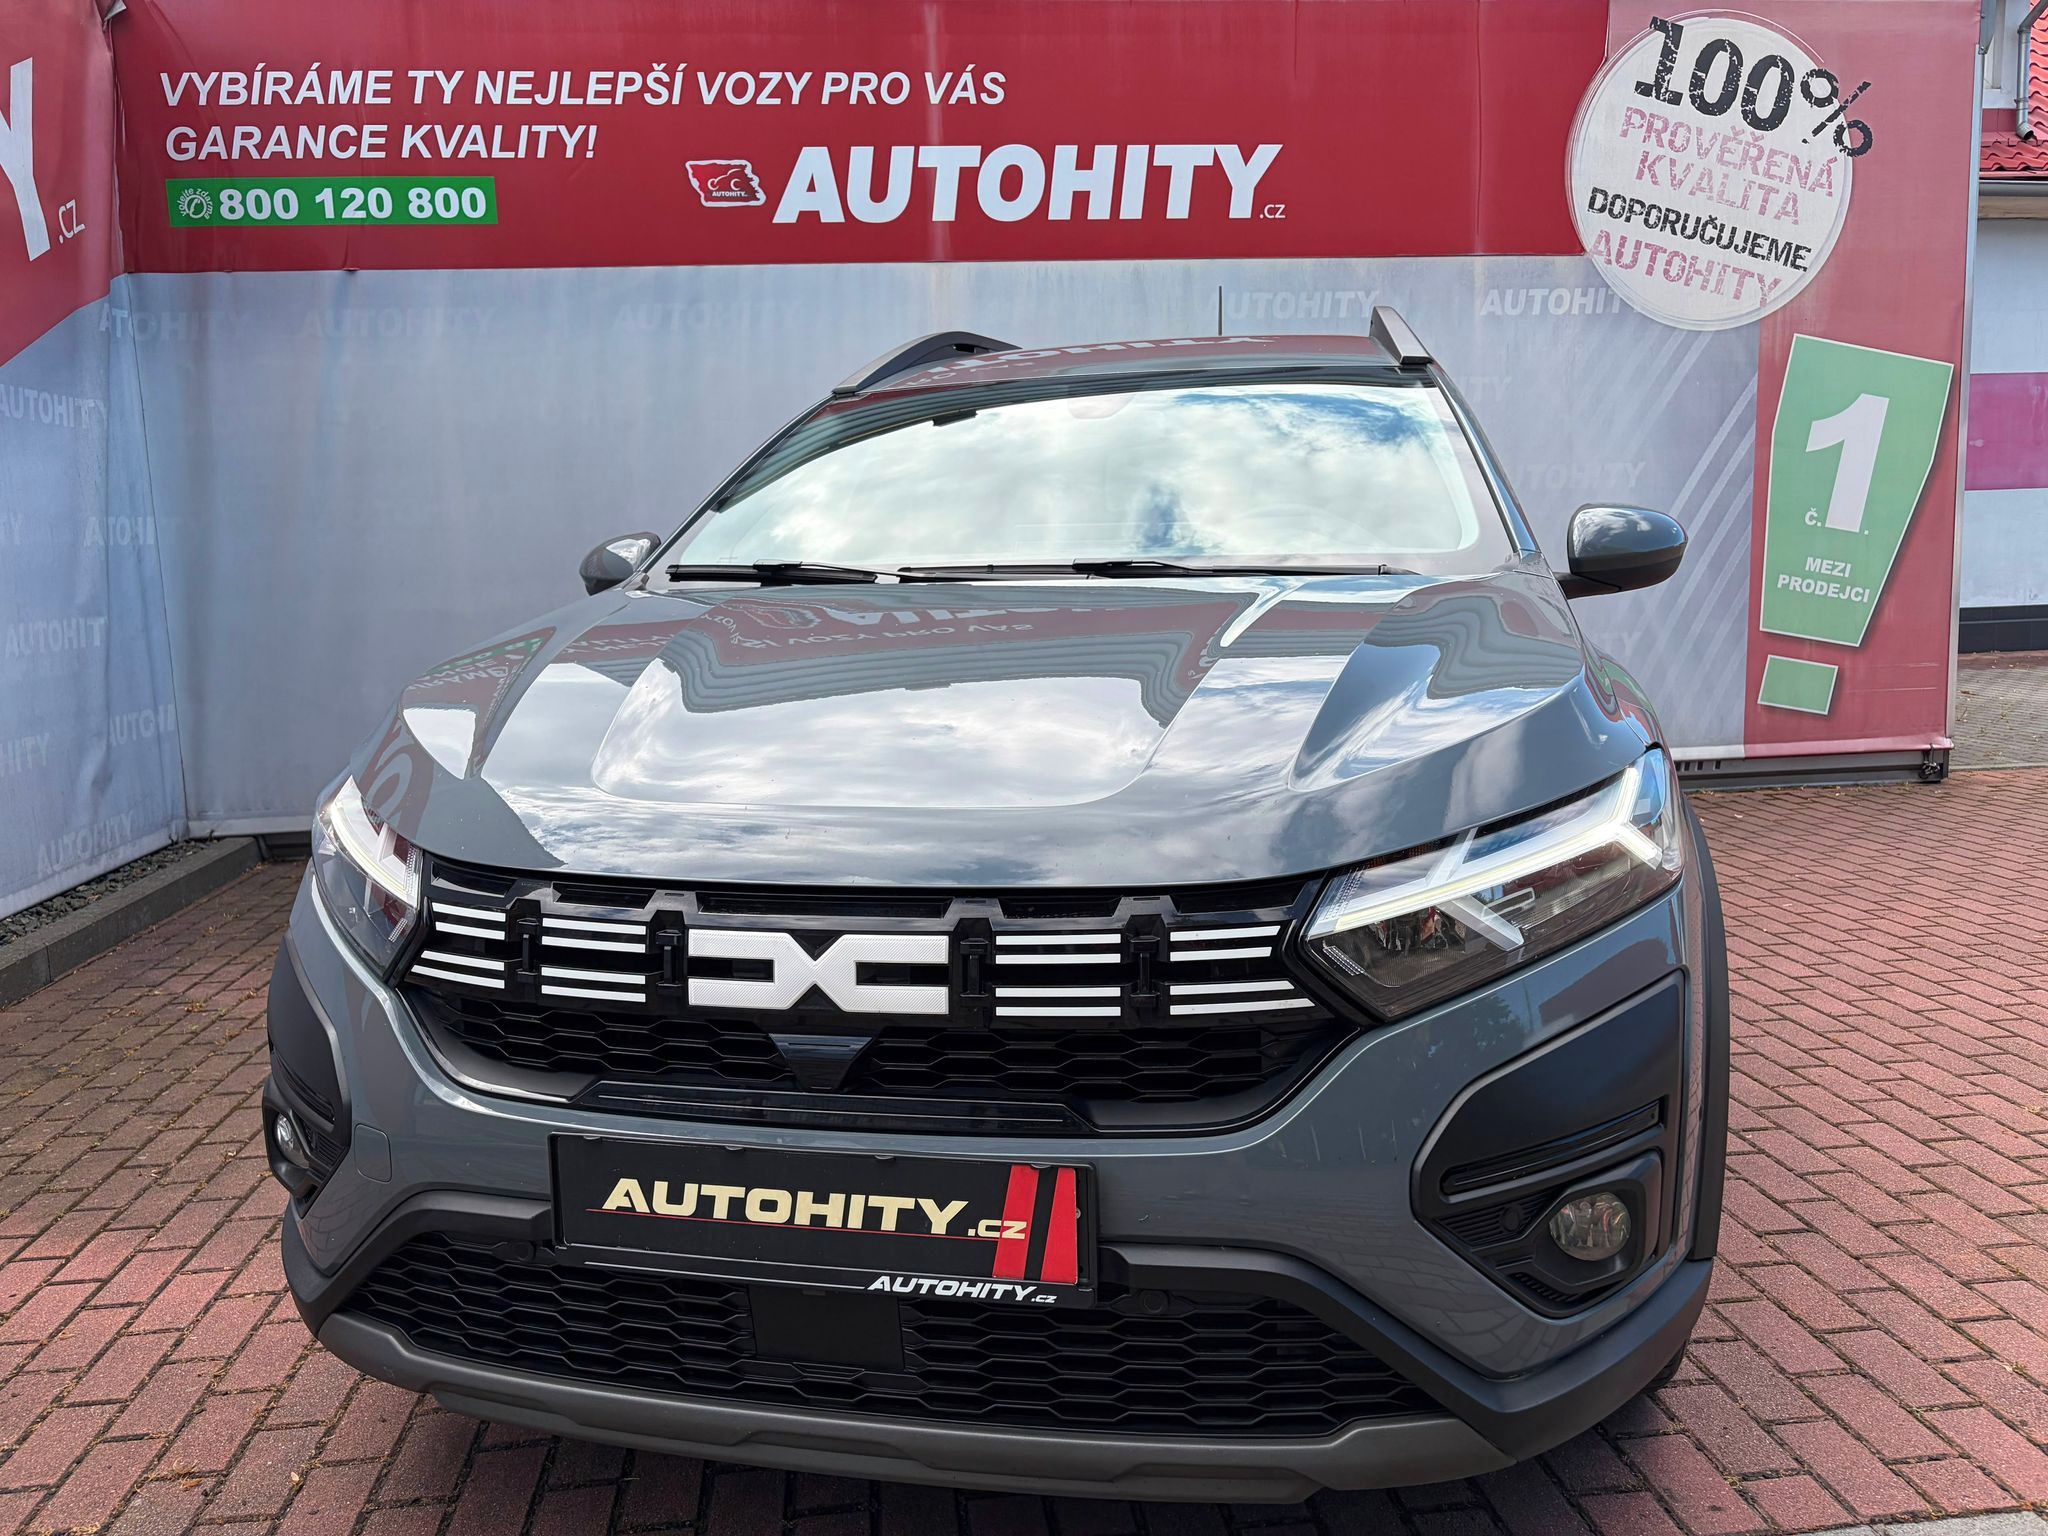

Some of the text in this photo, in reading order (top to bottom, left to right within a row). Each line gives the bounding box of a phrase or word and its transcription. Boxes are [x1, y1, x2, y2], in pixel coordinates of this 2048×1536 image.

[160, 62, 1007, 106] VYBÍRÁME TY NEJLEPŠÍ VOZY PRO VÁS
[1634, 16, 1873, 157] 100%
[165, 123, 598, 161] GARANCE KVALITY!
[1619, 106, 1838, 197] PROVĚŘENÁ
[219, 186, 487, 220] 800 120 800
[1635, 149, 1800, 226] KVALITA
[1587, 186, 1812, 272] DOPORUČUJEME
[1589, 229, 1782, 308] AUTOHITY
[1480, 287, 1636, 316] AUTOHIT
[1804, 556, 1852, 578] MEZI
[1777, 575, 1870, 603] PRODEJCI
[5, 615, 108, 658] AUTOHIT
